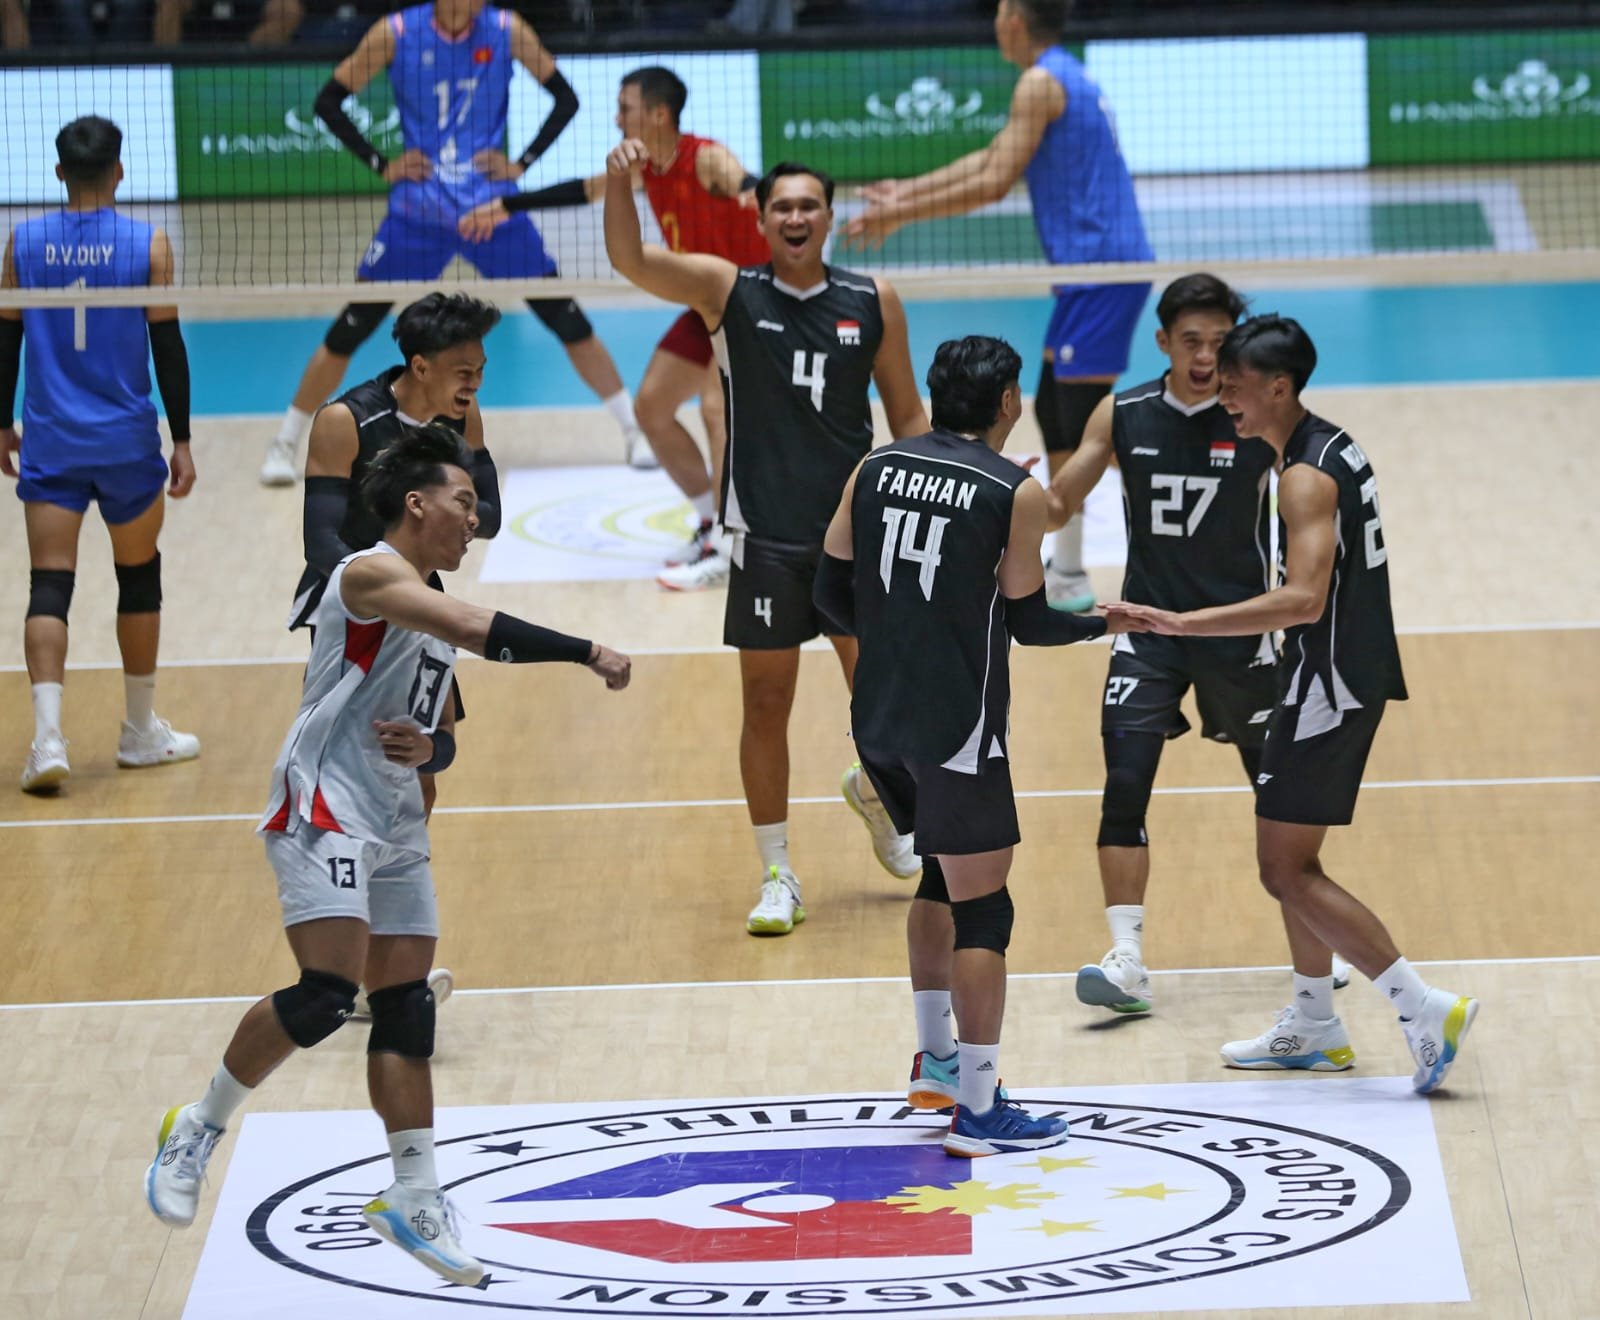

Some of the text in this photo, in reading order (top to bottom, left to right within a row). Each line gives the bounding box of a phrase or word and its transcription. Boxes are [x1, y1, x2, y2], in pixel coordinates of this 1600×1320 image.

[433, 77, 478, 130] 17
[45, 243, 113, 266] D.V.DUY
[792, 349, 828, 412] 4
[876, 466, 977, 511] FARHAN
[1150, 472, 1222, 538] 27
[879, 506, 951, 602] 14
[754, 597, 772, 628] 4
[408, 647, 451, 729] 13
[1104, 676, 1140, 706] 27
[327, 856, 357, 889] 13
[556, 1106, 1357, 1307] PHILIPNE SPORTS COMMISSION
